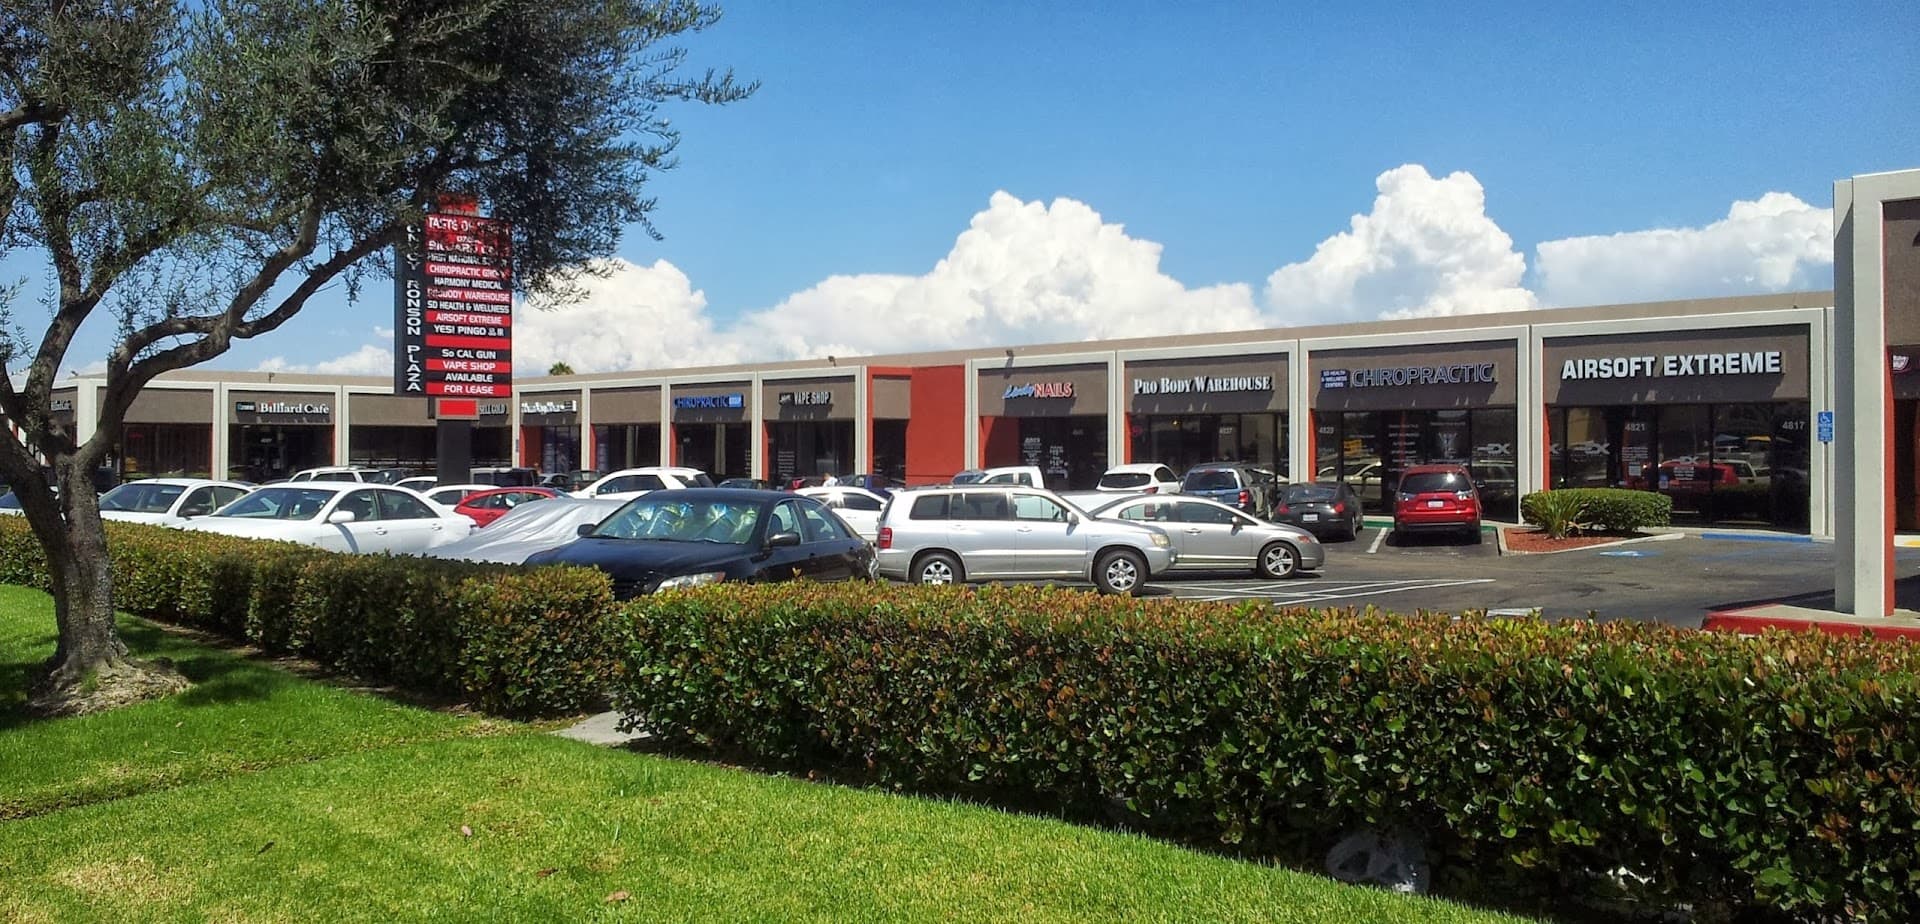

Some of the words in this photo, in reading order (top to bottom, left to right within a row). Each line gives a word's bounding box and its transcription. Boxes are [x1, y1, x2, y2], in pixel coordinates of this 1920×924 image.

[429, 264, 480, 277] CHIROPRACTIC
[434, 277, 470, 288] HARMONY
[471, 280, 503, 290] MEDICAL
[464, 290, 510, 302] WAREHOUSE
[406, 280, 421, 335] RONSON
[427, 300, 438, 309] SD
[440, 301, 464, 311] HEALTH
[465, 302, 472, 311] &
[473, 303, 509, 314] WELLNESS
[436, 313, 467, 323] AIRSOFT
[469, 315, 502, 325] EXTREME
[457, 326, 486, 336] PINGO
[442, 348, 455, 358] So
[456, 350, 474, 358] CAL
[476, 351, 496, 360] GUN
[406, 345, 421, 391] PLAZA
[443, 361, 467, 370] VAPE
[470, 362, 496, 371] SHOP
[1562, 357, 1655, 380] AIRSOFT
[1663, 351, 1781, 377] EXTREME
[445, 373, 493, 383] AVAILABLE
[1352, 363, 1494, 388] CHIROPRACTIC
[444, 385, 463, 393] FOR
[465, 386, 494, 394] LEASE
[1034, 383, 1073, 397] NAILS
[794, 392, 810, 405] VAPE
[811, 392, 830, 405] SHOP
[260, 401, 302, 413] Billiard
[304, 404, 330, 414] Cafe
[1625, 424, 1646, 432] 4821
[1782, 421, 1805, 430] 4817
